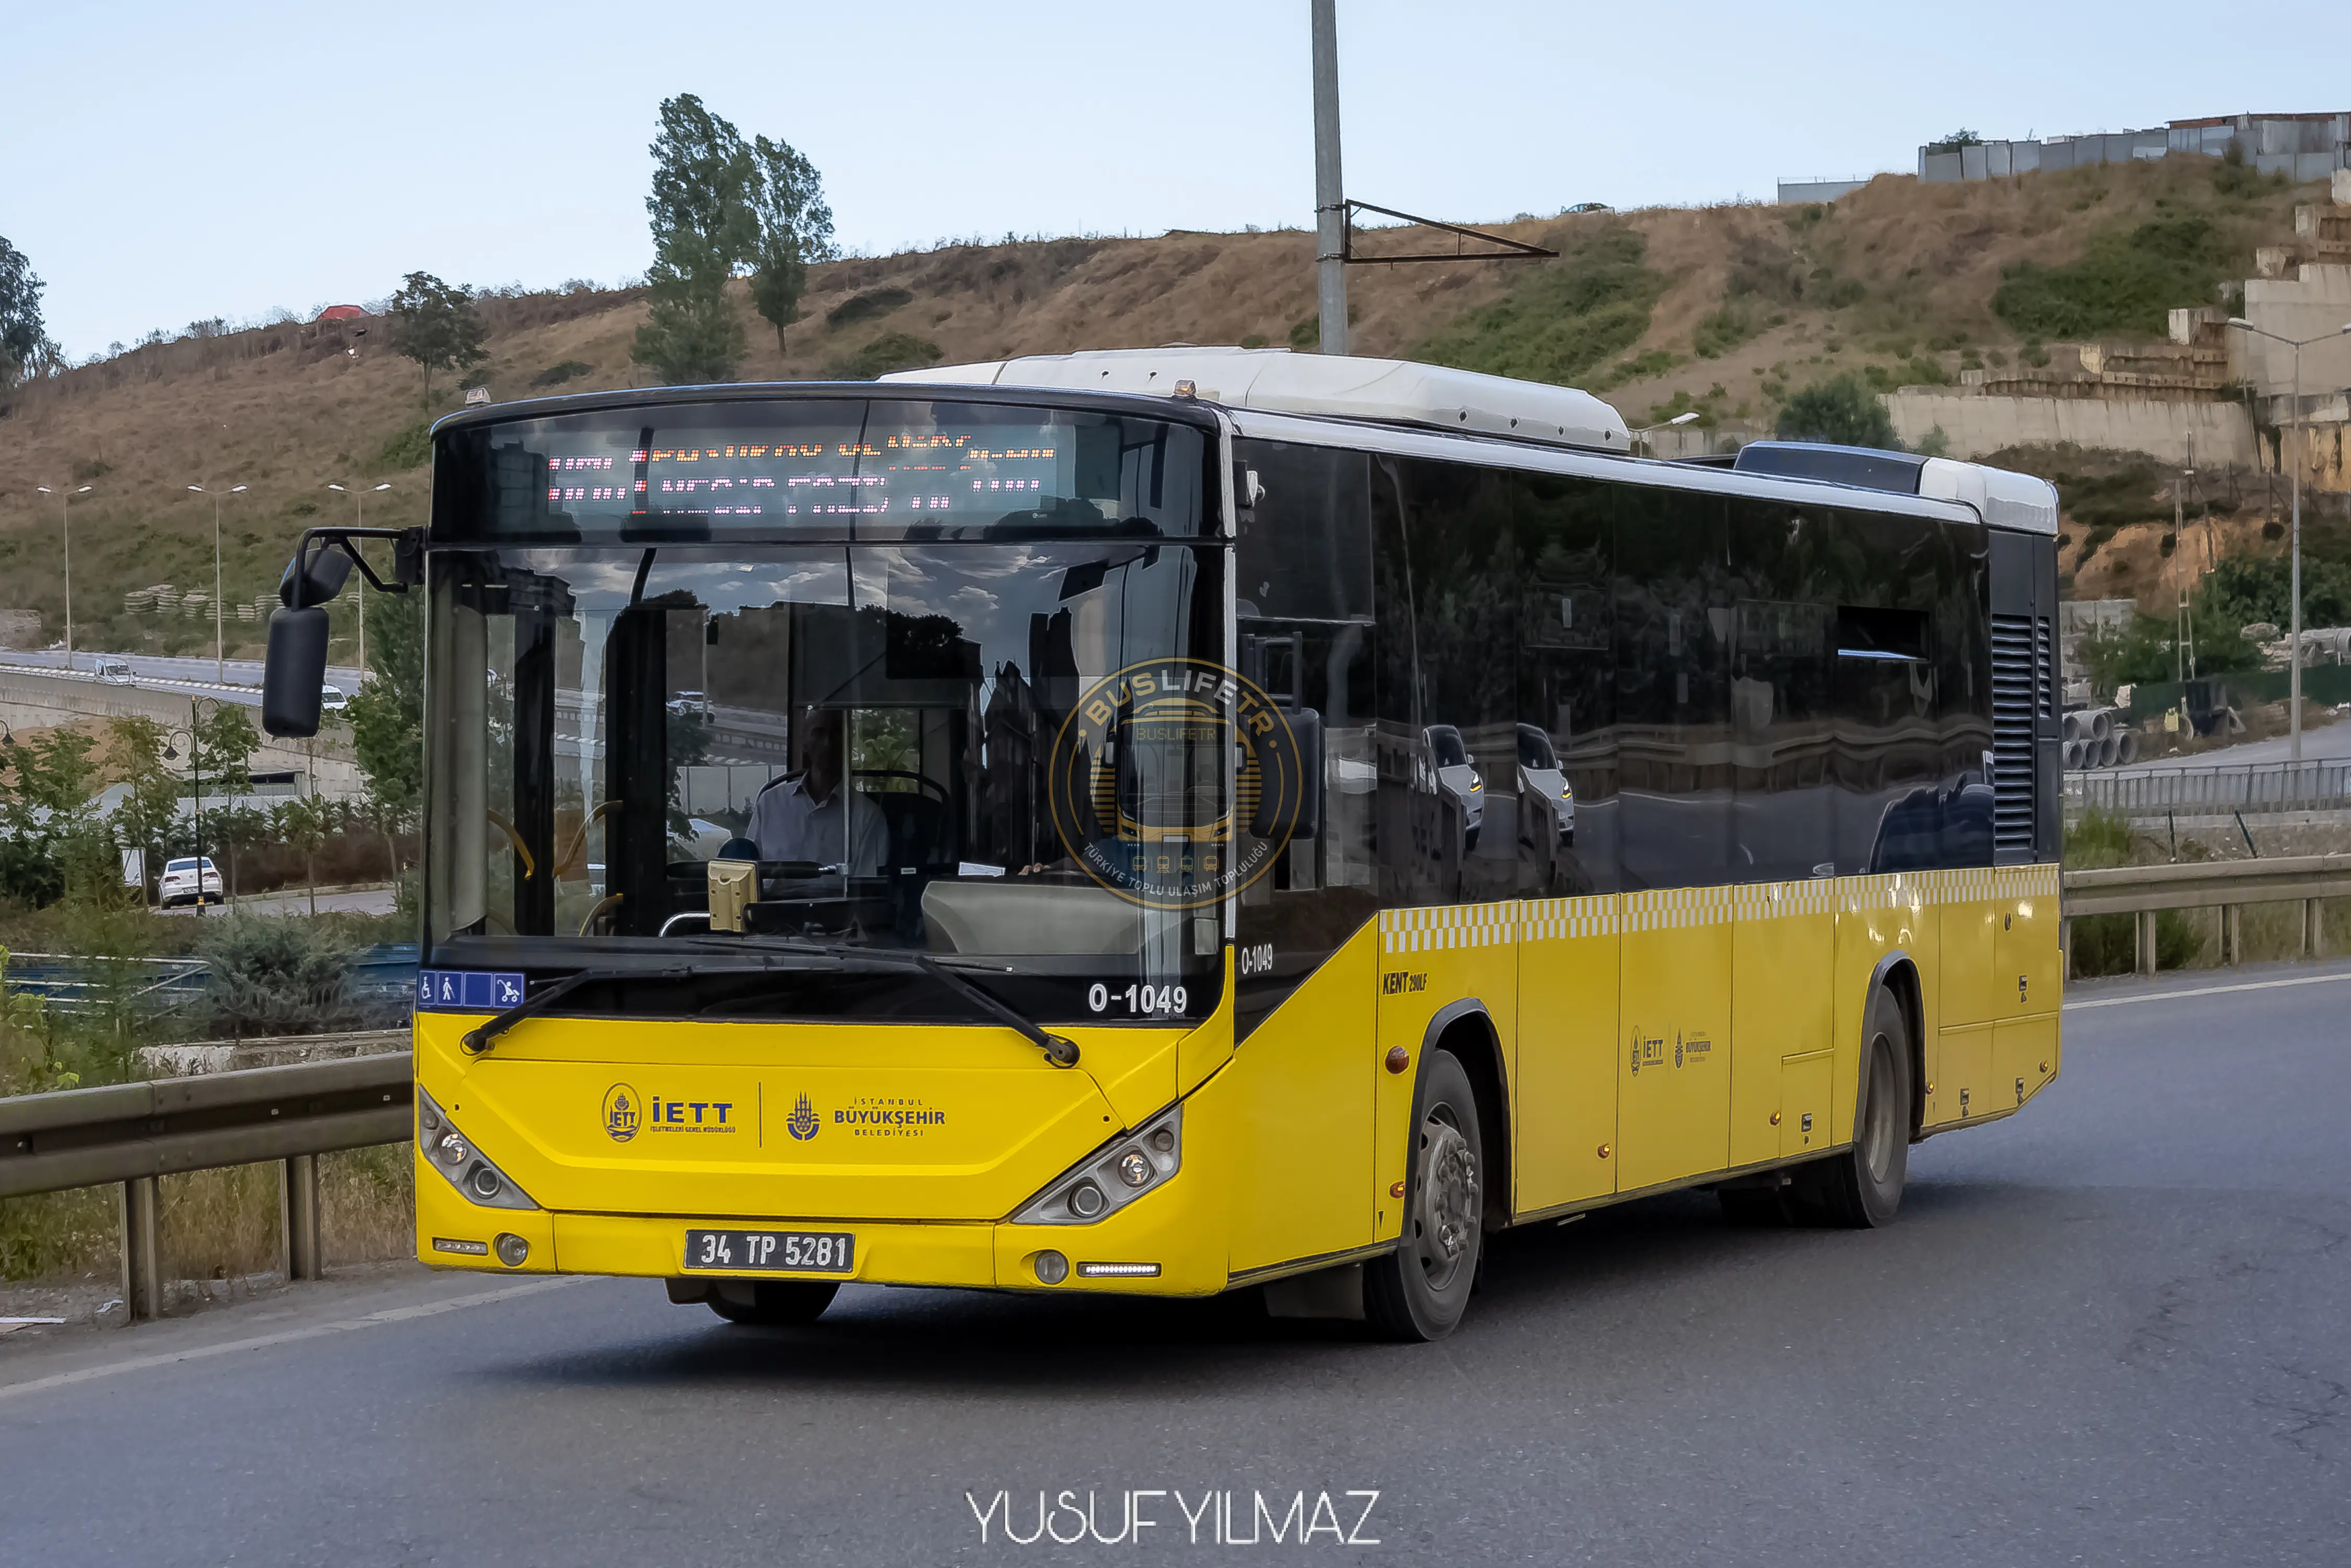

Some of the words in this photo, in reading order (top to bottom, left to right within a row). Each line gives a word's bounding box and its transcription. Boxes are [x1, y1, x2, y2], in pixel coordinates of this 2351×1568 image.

[1382, 971, 1408, 995] KENT
[854, 1096, 923, 1106] İSTANBUL
[834, 1106, 945, 1128] BÜYÜKŞEHİR
[701, 1234, 731, 1263] 34
[746, 1236, 776, 1264] TP
[786, 1236, 846, 1267] 5281
